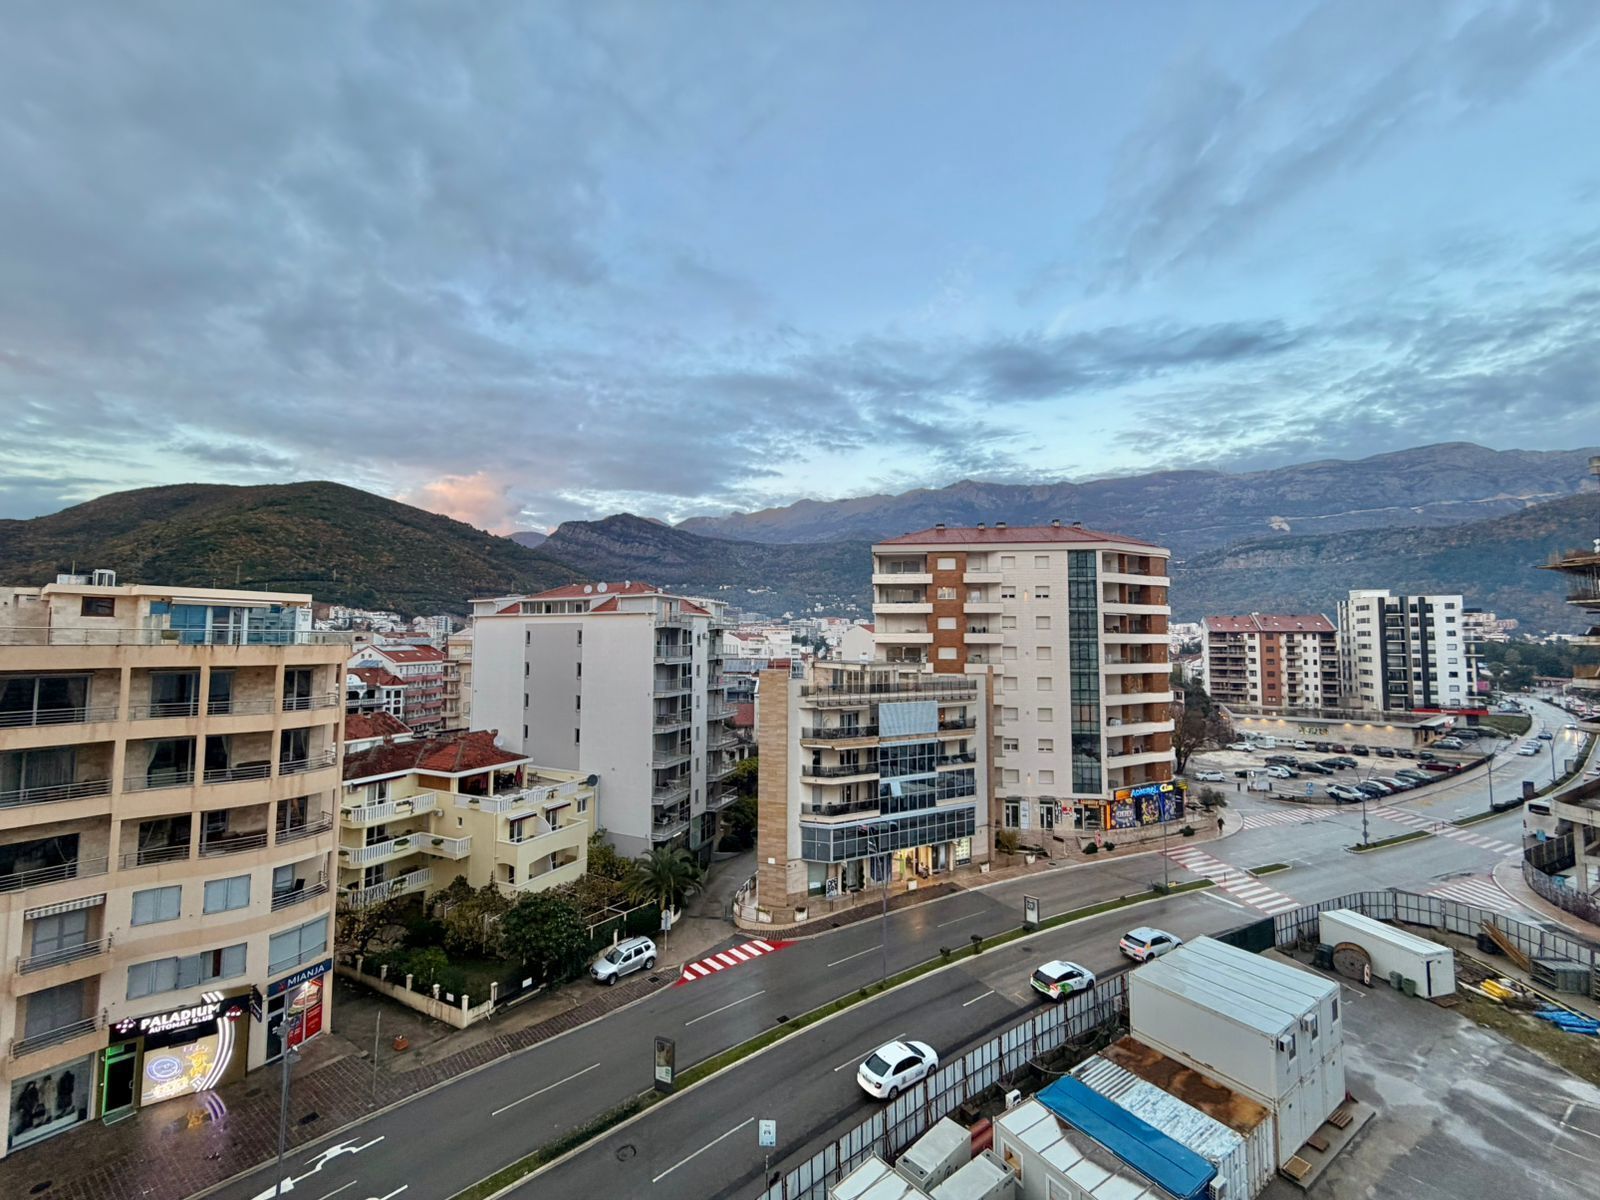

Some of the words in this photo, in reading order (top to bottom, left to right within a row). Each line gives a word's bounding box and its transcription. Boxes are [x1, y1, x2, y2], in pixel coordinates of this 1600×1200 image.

[287, 964, 325, 987] MIANJA
[140, 1002, 221, 1030] PALADIUM
[148, 1019, 191, 1034] AUTOMAT
[192, 1014, 214, 1025] KLUB
